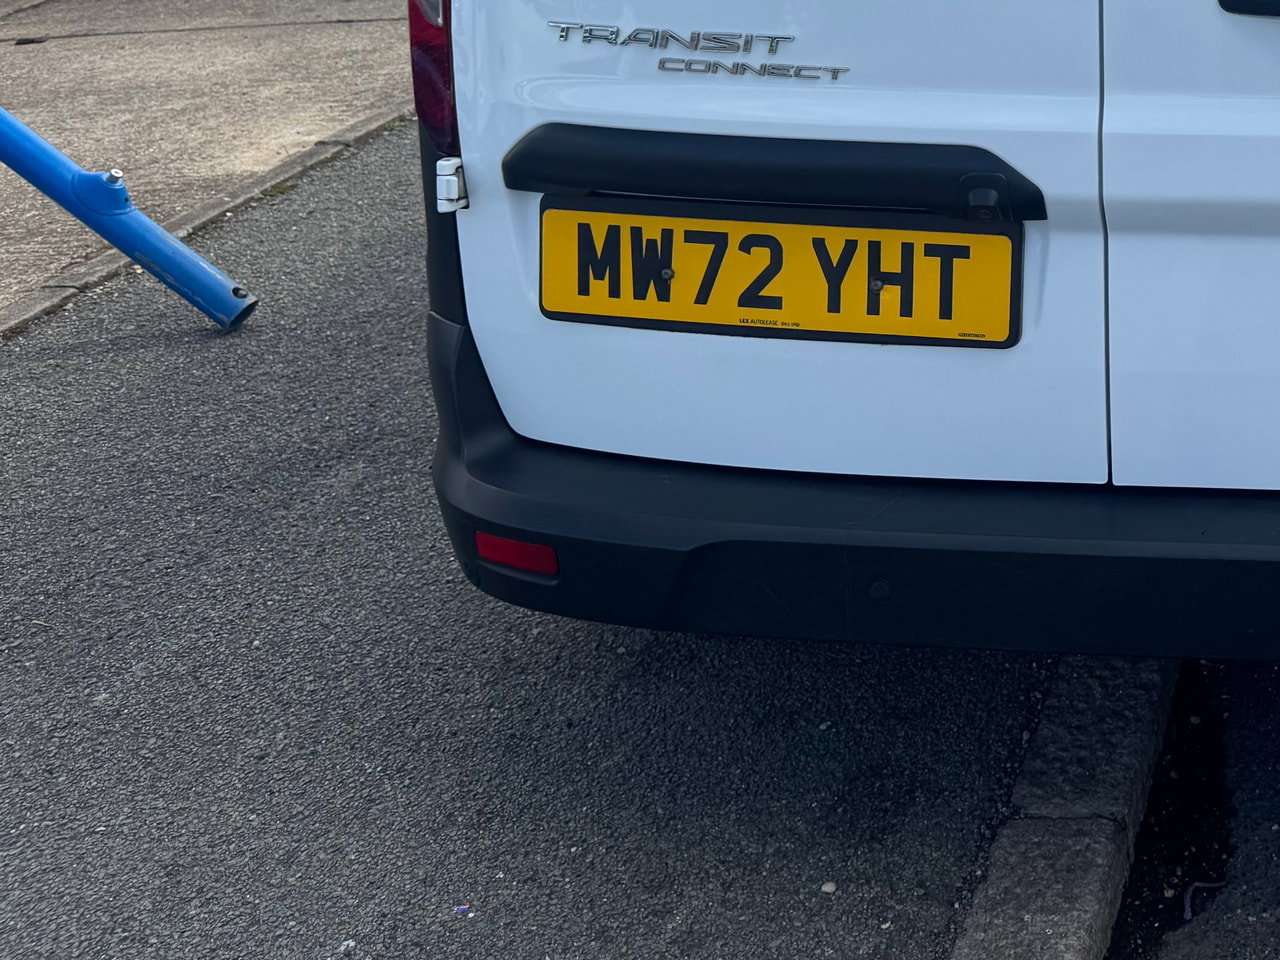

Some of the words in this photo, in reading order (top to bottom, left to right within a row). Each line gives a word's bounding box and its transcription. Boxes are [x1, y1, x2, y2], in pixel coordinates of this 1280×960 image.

[547, 20, 796, 56] TRANSIT
[658, 57, 850, 81] CONNECT
[576, 222, 784, 311] MW72
[811, 236, 971, 321] YHT
